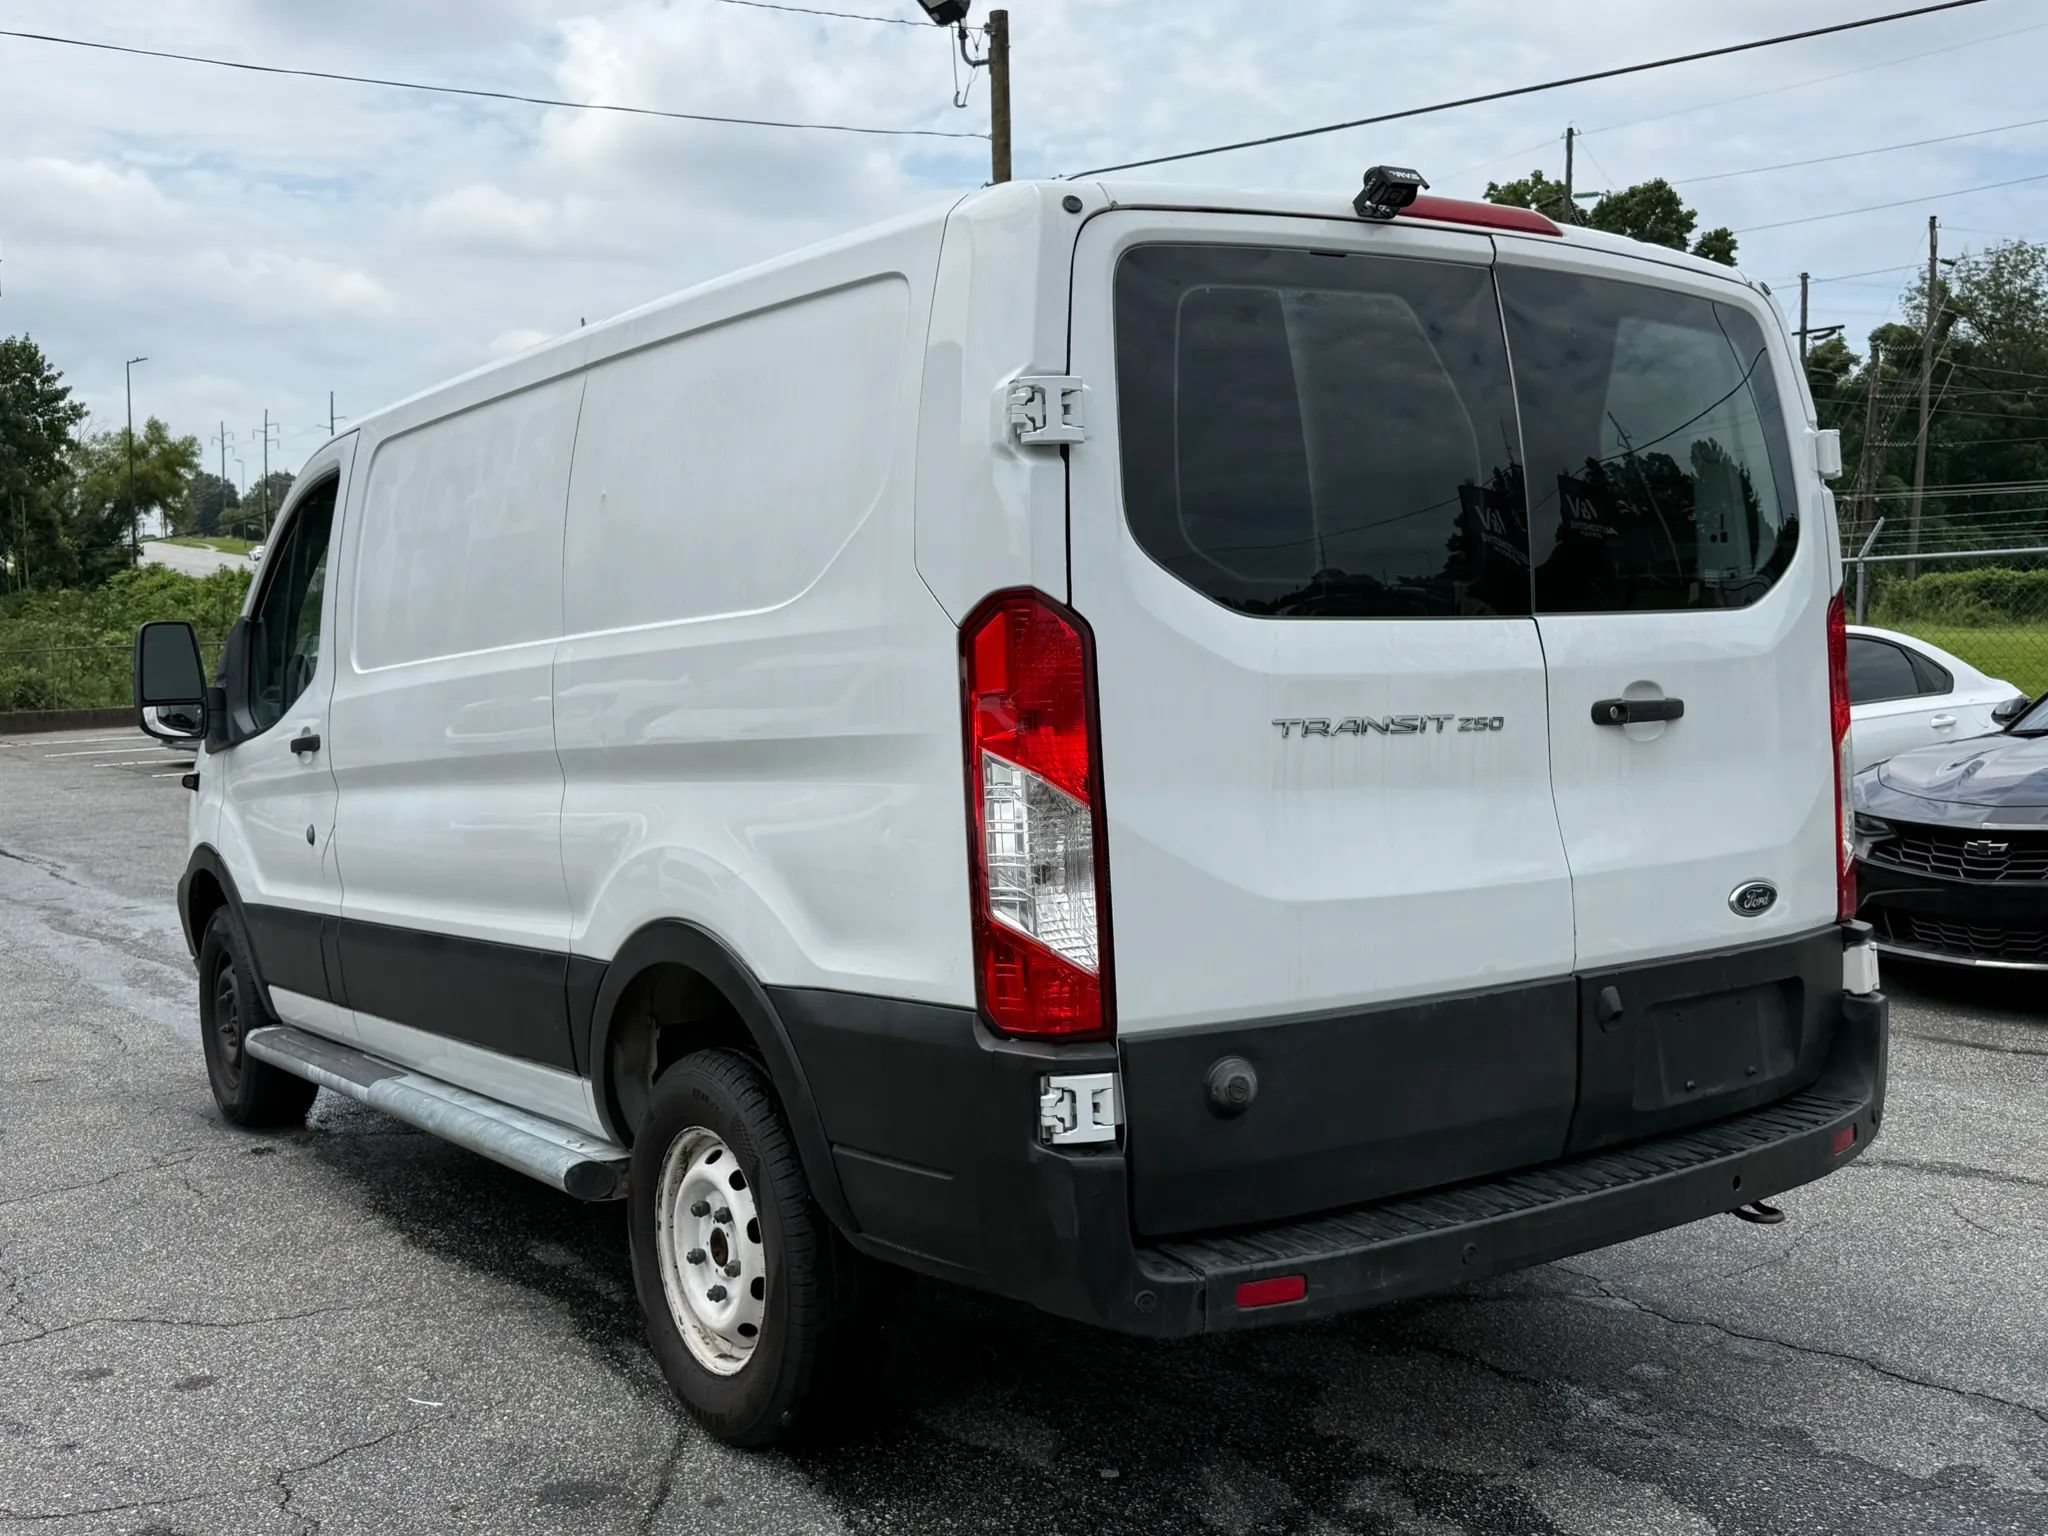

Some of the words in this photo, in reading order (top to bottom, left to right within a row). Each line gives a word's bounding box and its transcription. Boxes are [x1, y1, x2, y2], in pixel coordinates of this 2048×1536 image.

[1271, 714, 1455, 737] TRANSIT
[1457, 716, 1504, 732] 250
[1743, 888, 1770, 909] Ford
